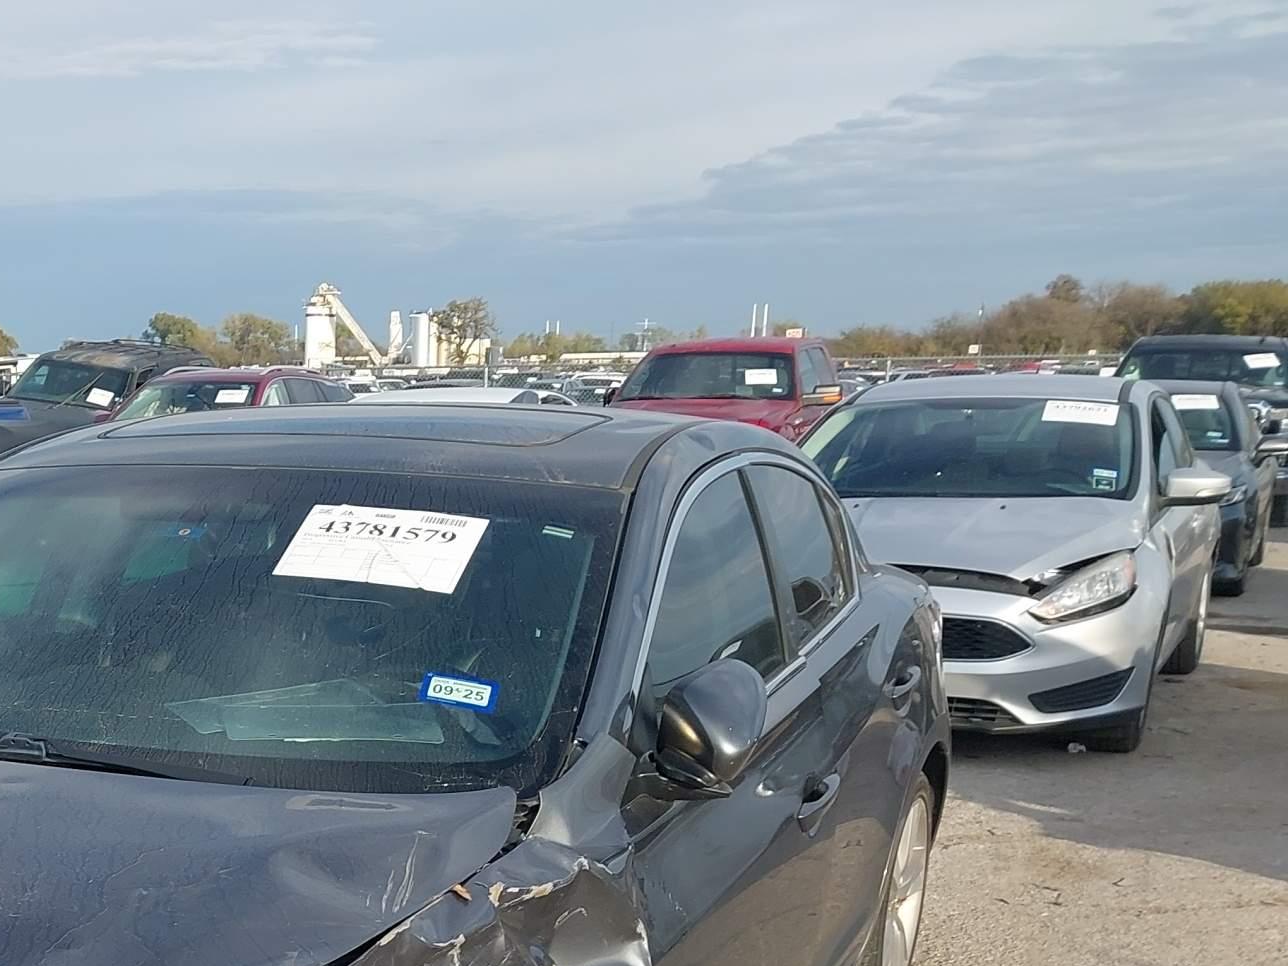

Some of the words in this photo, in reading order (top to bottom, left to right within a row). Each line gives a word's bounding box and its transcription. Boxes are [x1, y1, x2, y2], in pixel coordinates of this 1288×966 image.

[319, 520, 457, 544] 43781579
[433, 684, 454, 696] 09
[462, 689, 485, 702] 25
